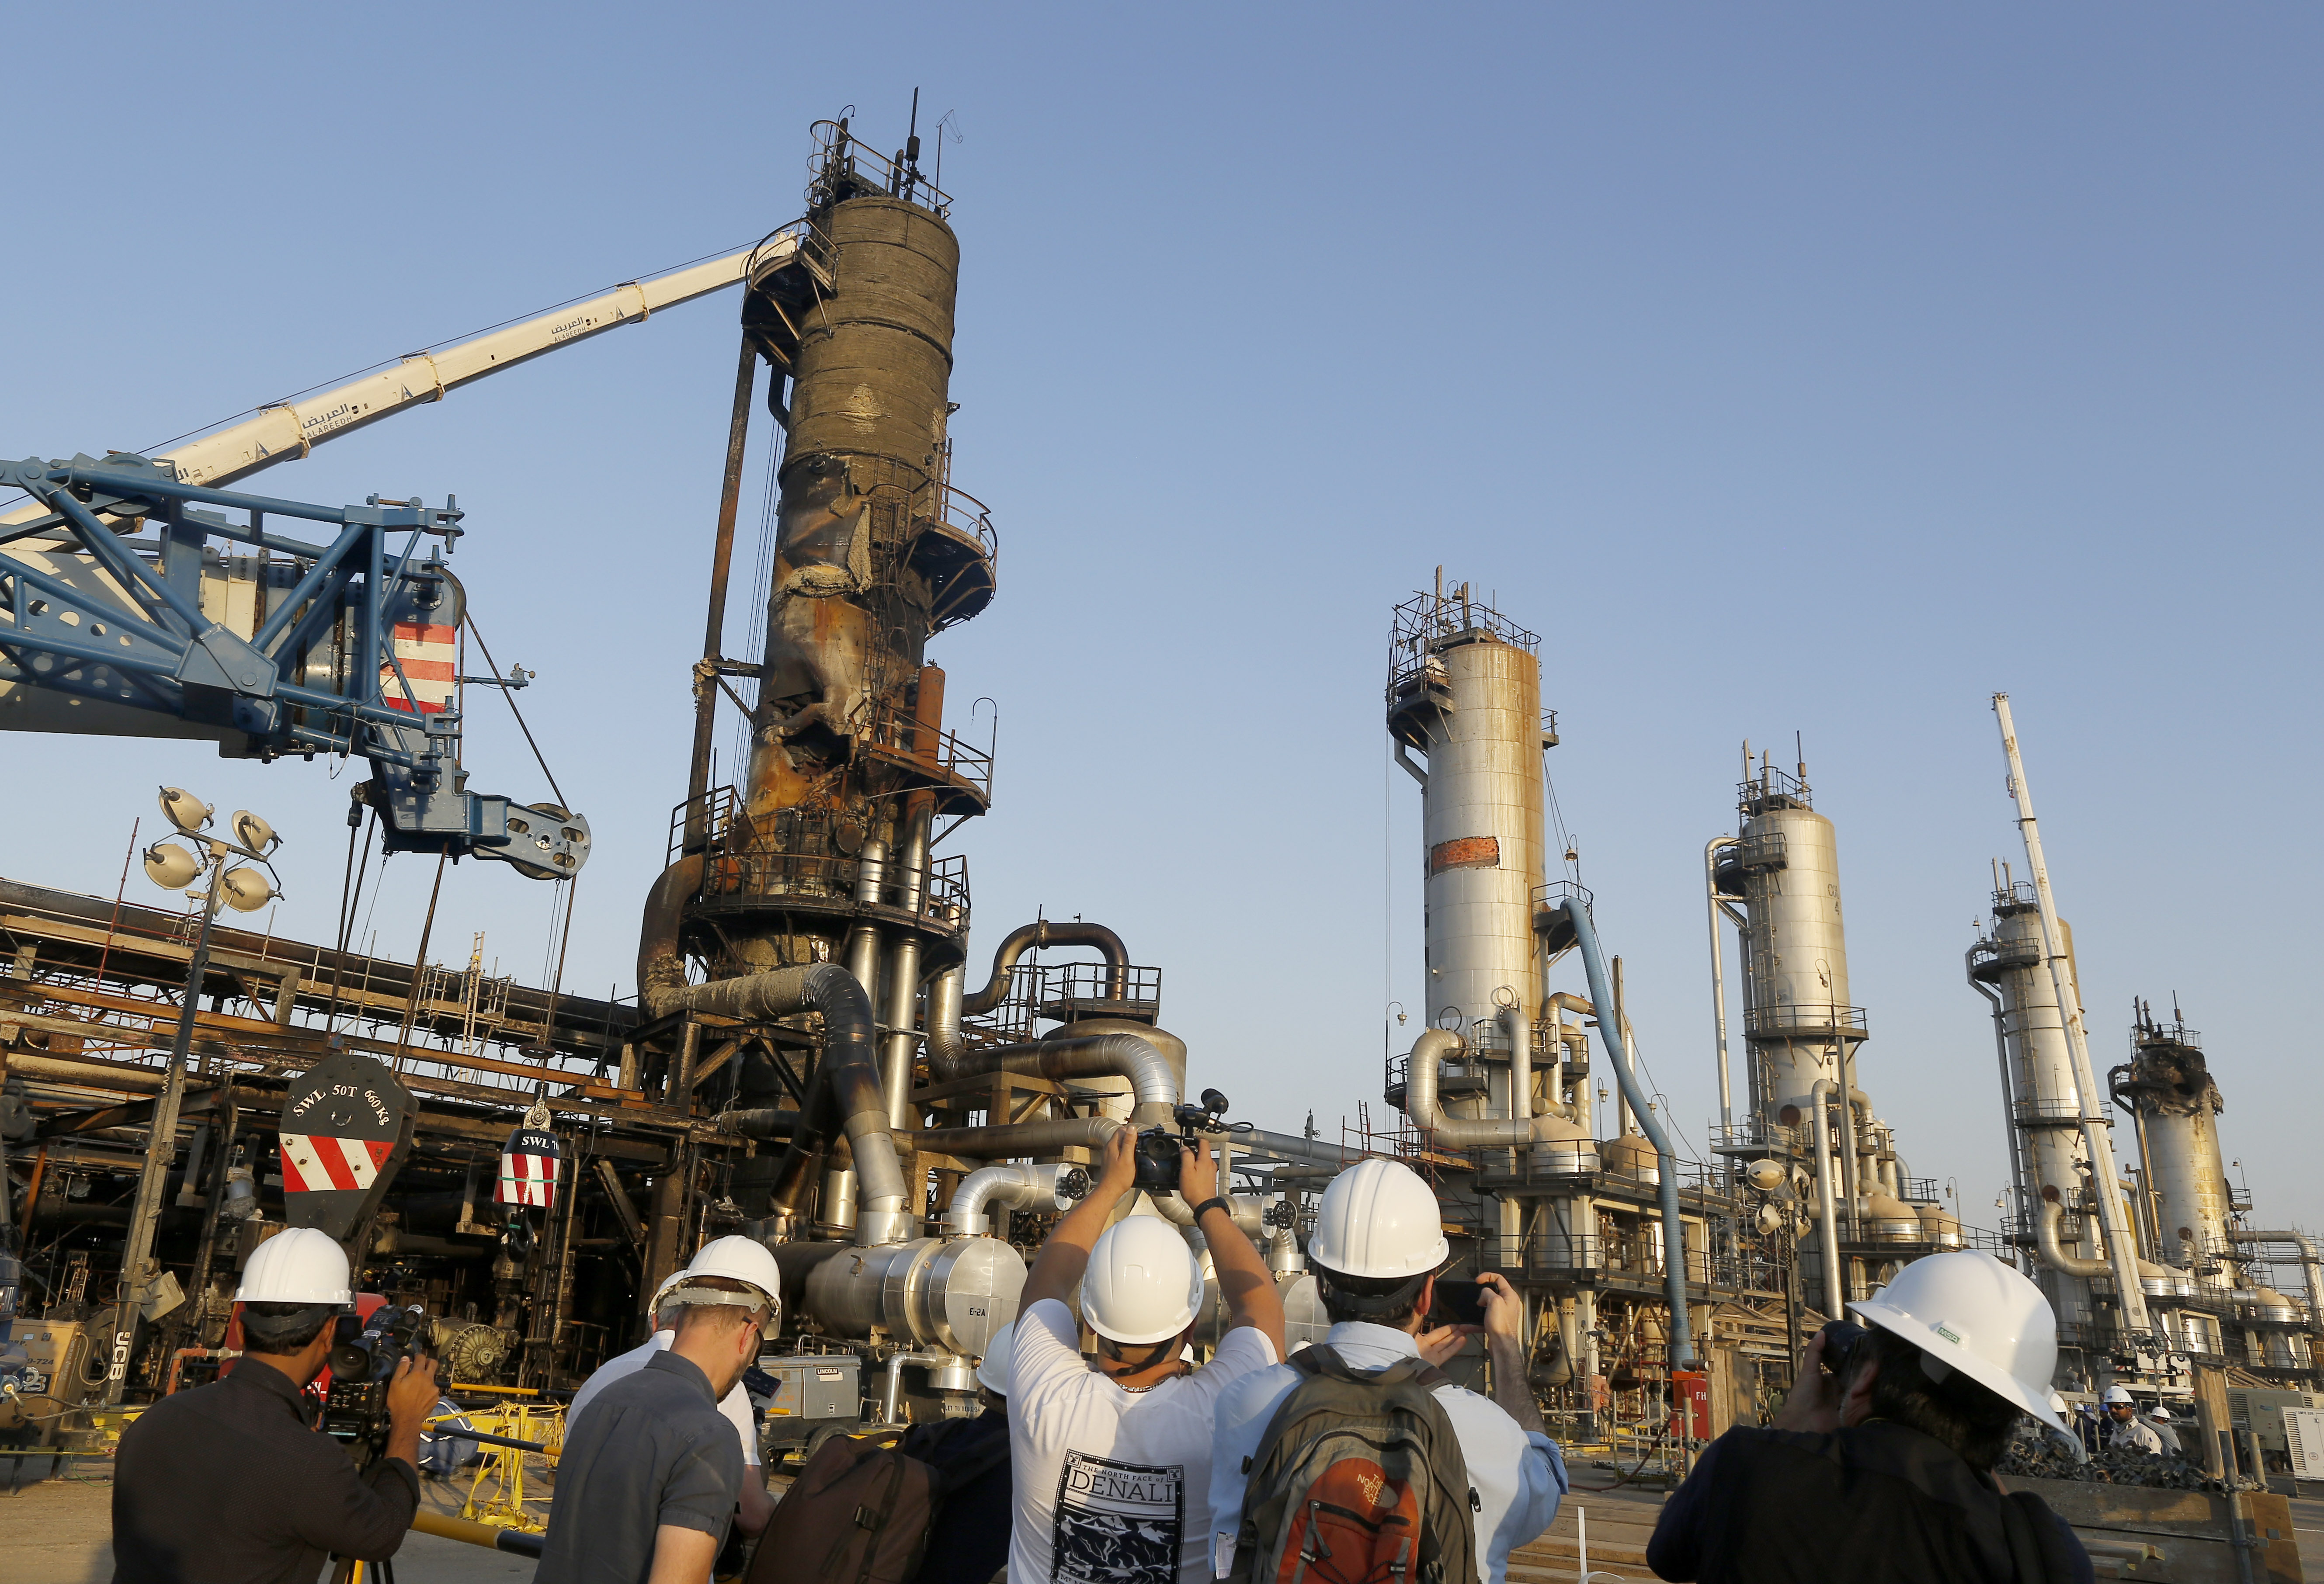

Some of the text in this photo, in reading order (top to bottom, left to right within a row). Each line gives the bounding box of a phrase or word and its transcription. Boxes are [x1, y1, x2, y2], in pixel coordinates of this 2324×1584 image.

[551, 316, 584, 334] العريض
[554, 326, 587, 343] ALAREEDH
[302, 403, 349, 429] العريض
[307, 416, 353, 439] ALAREEDH
[293, 1084, 390, 1126] SWL 50T 660 Kg
[521, 1136, 549, 1149] SWL
[969, 1307, 985, 1316] E-2A
[1939, 1328, 1958, 1343] MSA
[109, 1332, 131, 1380] JCB
[1084, 1465, 1098, 1473] THE
[1101, 1469, 1129, 1480] NORTH
[1070, 1470, 1172, 1502] DENALI
[1357, 1473, 1382, 1499] NORTH
[1373, 1473, 1384, 1491] THE
[1363, 1487, 1380, 1506] FACE
